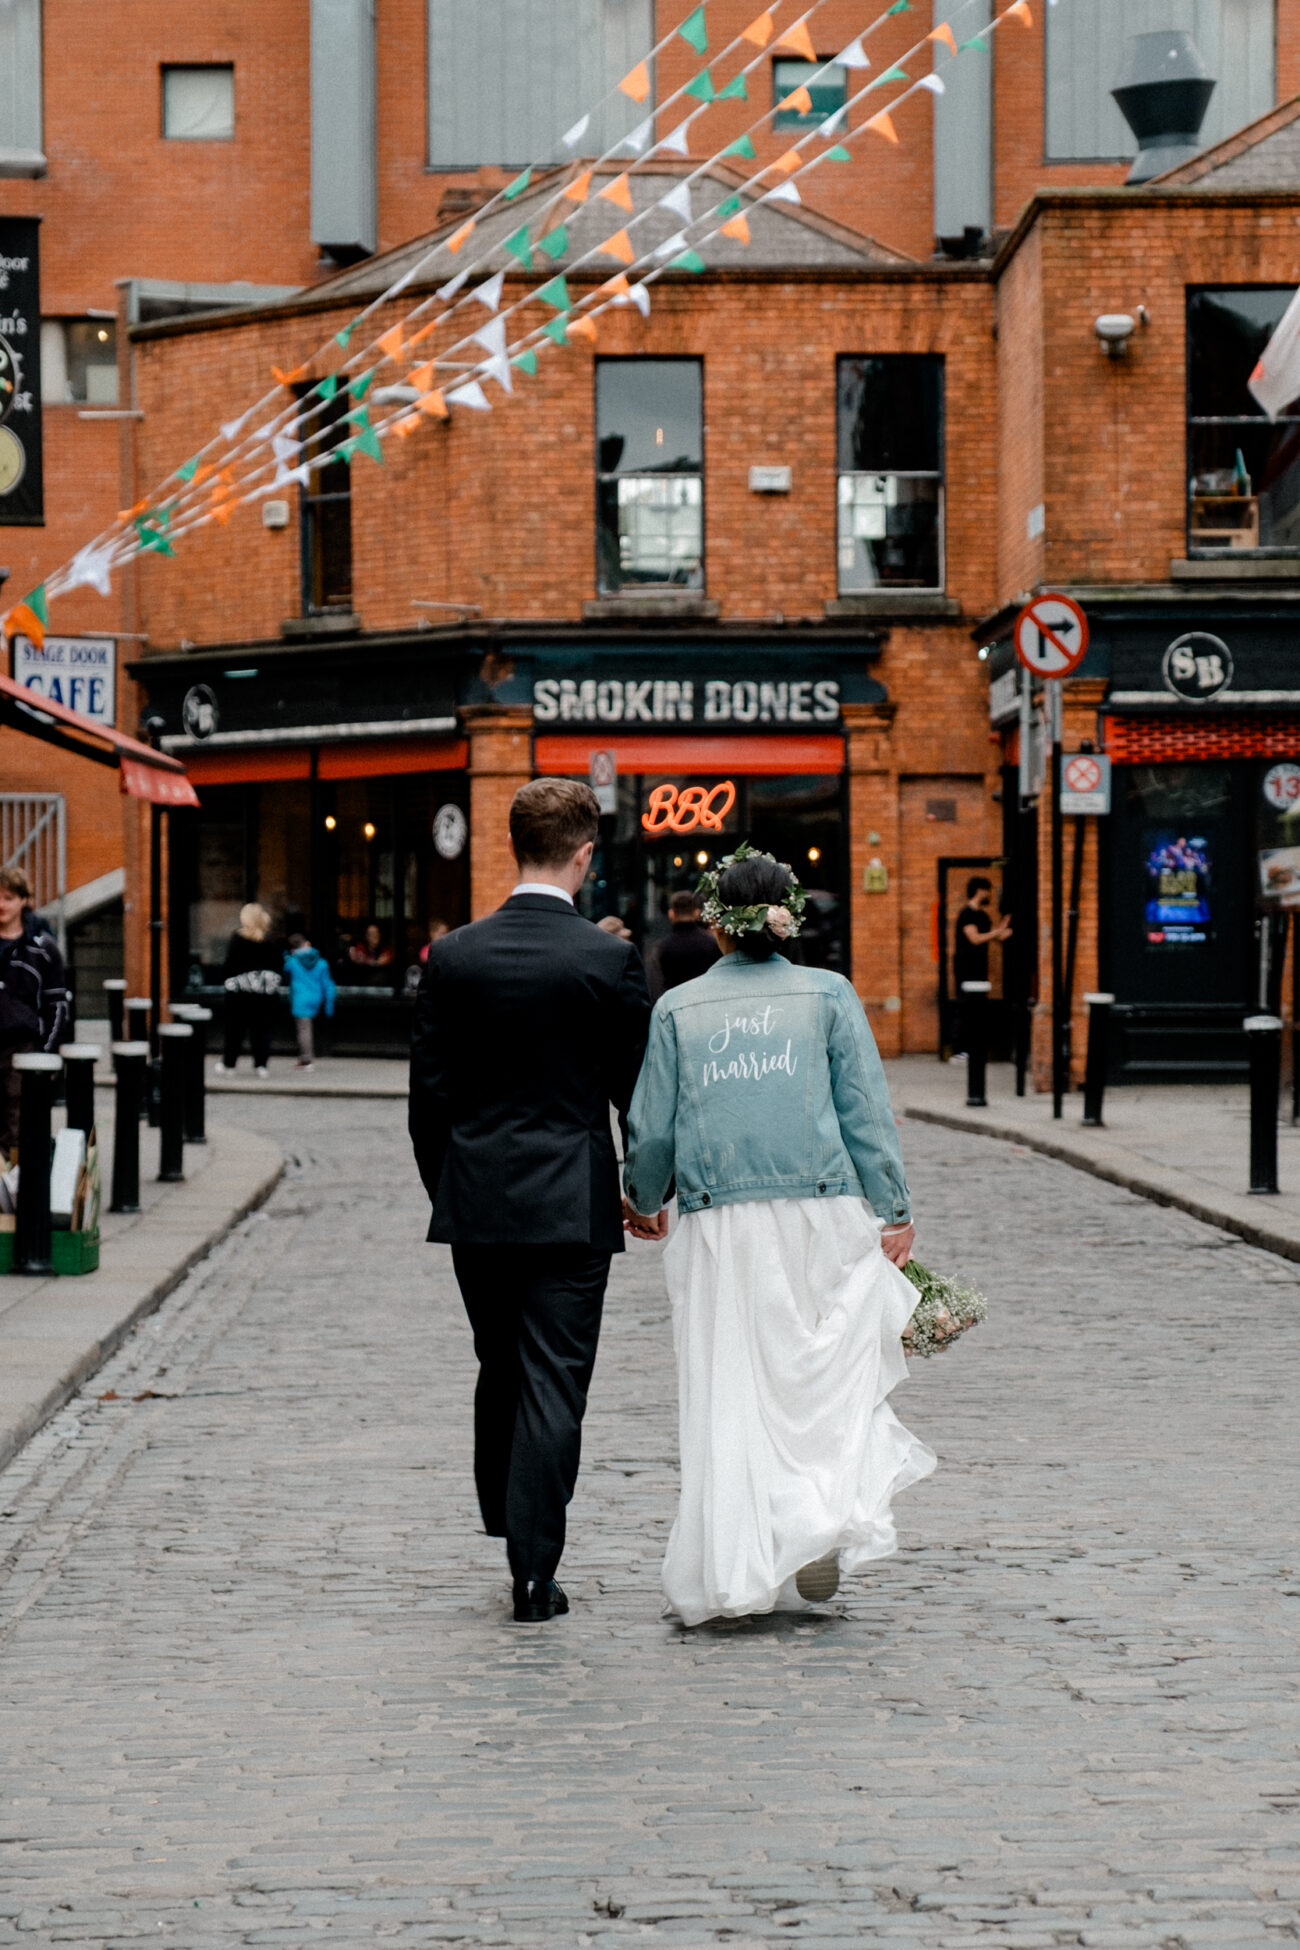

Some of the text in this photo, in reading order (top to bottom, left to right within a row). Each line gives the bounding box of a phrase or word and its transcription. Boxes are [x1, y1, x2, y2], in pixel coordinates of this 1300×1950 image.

[70, 646, 107, 664] DOOR
[1171, 646, 1225, 688] SB
[533, 679, 840, 722] SMOKIN BONES
[641, 780, 736, 832] BBQ
[708, 1005, 785, 1054] just
[703, 1038, 798, 1087] married
